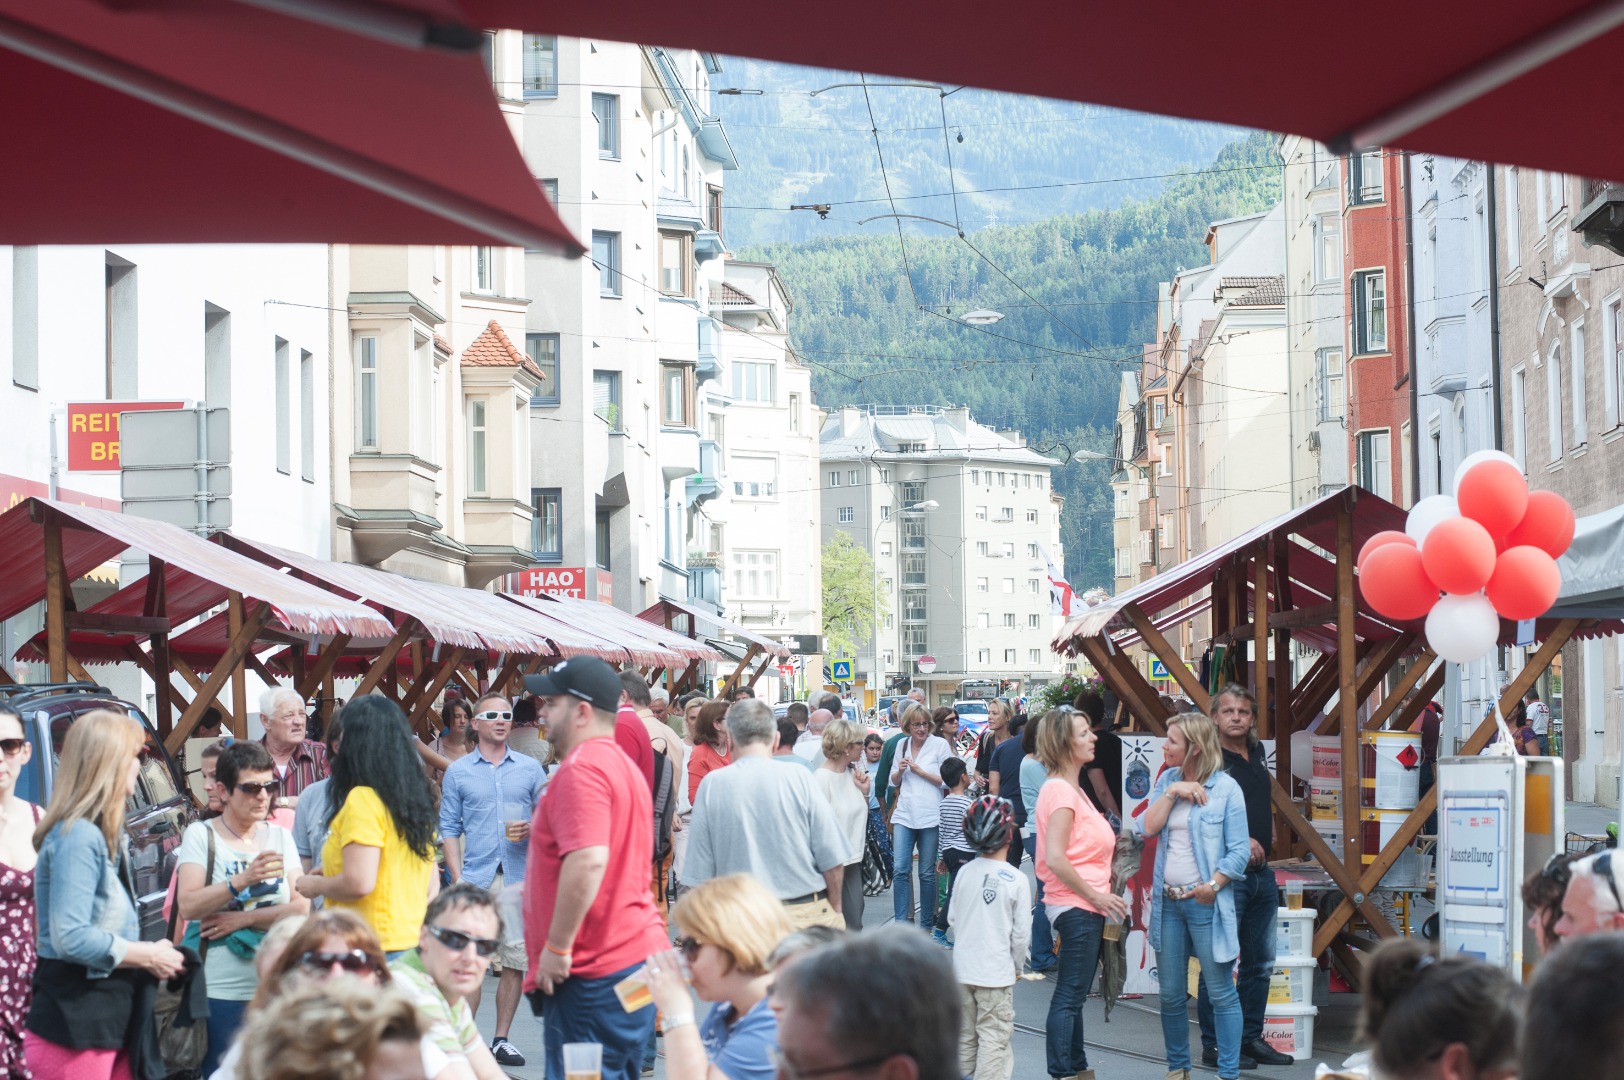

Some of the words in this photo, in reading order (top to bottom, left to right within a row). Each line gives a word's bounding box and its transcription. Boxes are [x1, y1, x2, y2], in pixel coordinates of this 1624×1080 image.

[530, 571, 574, 586] HAO
[523, 588, 581, 599] MRKT
[1449, 846, 1494, 867] Ausstellung
